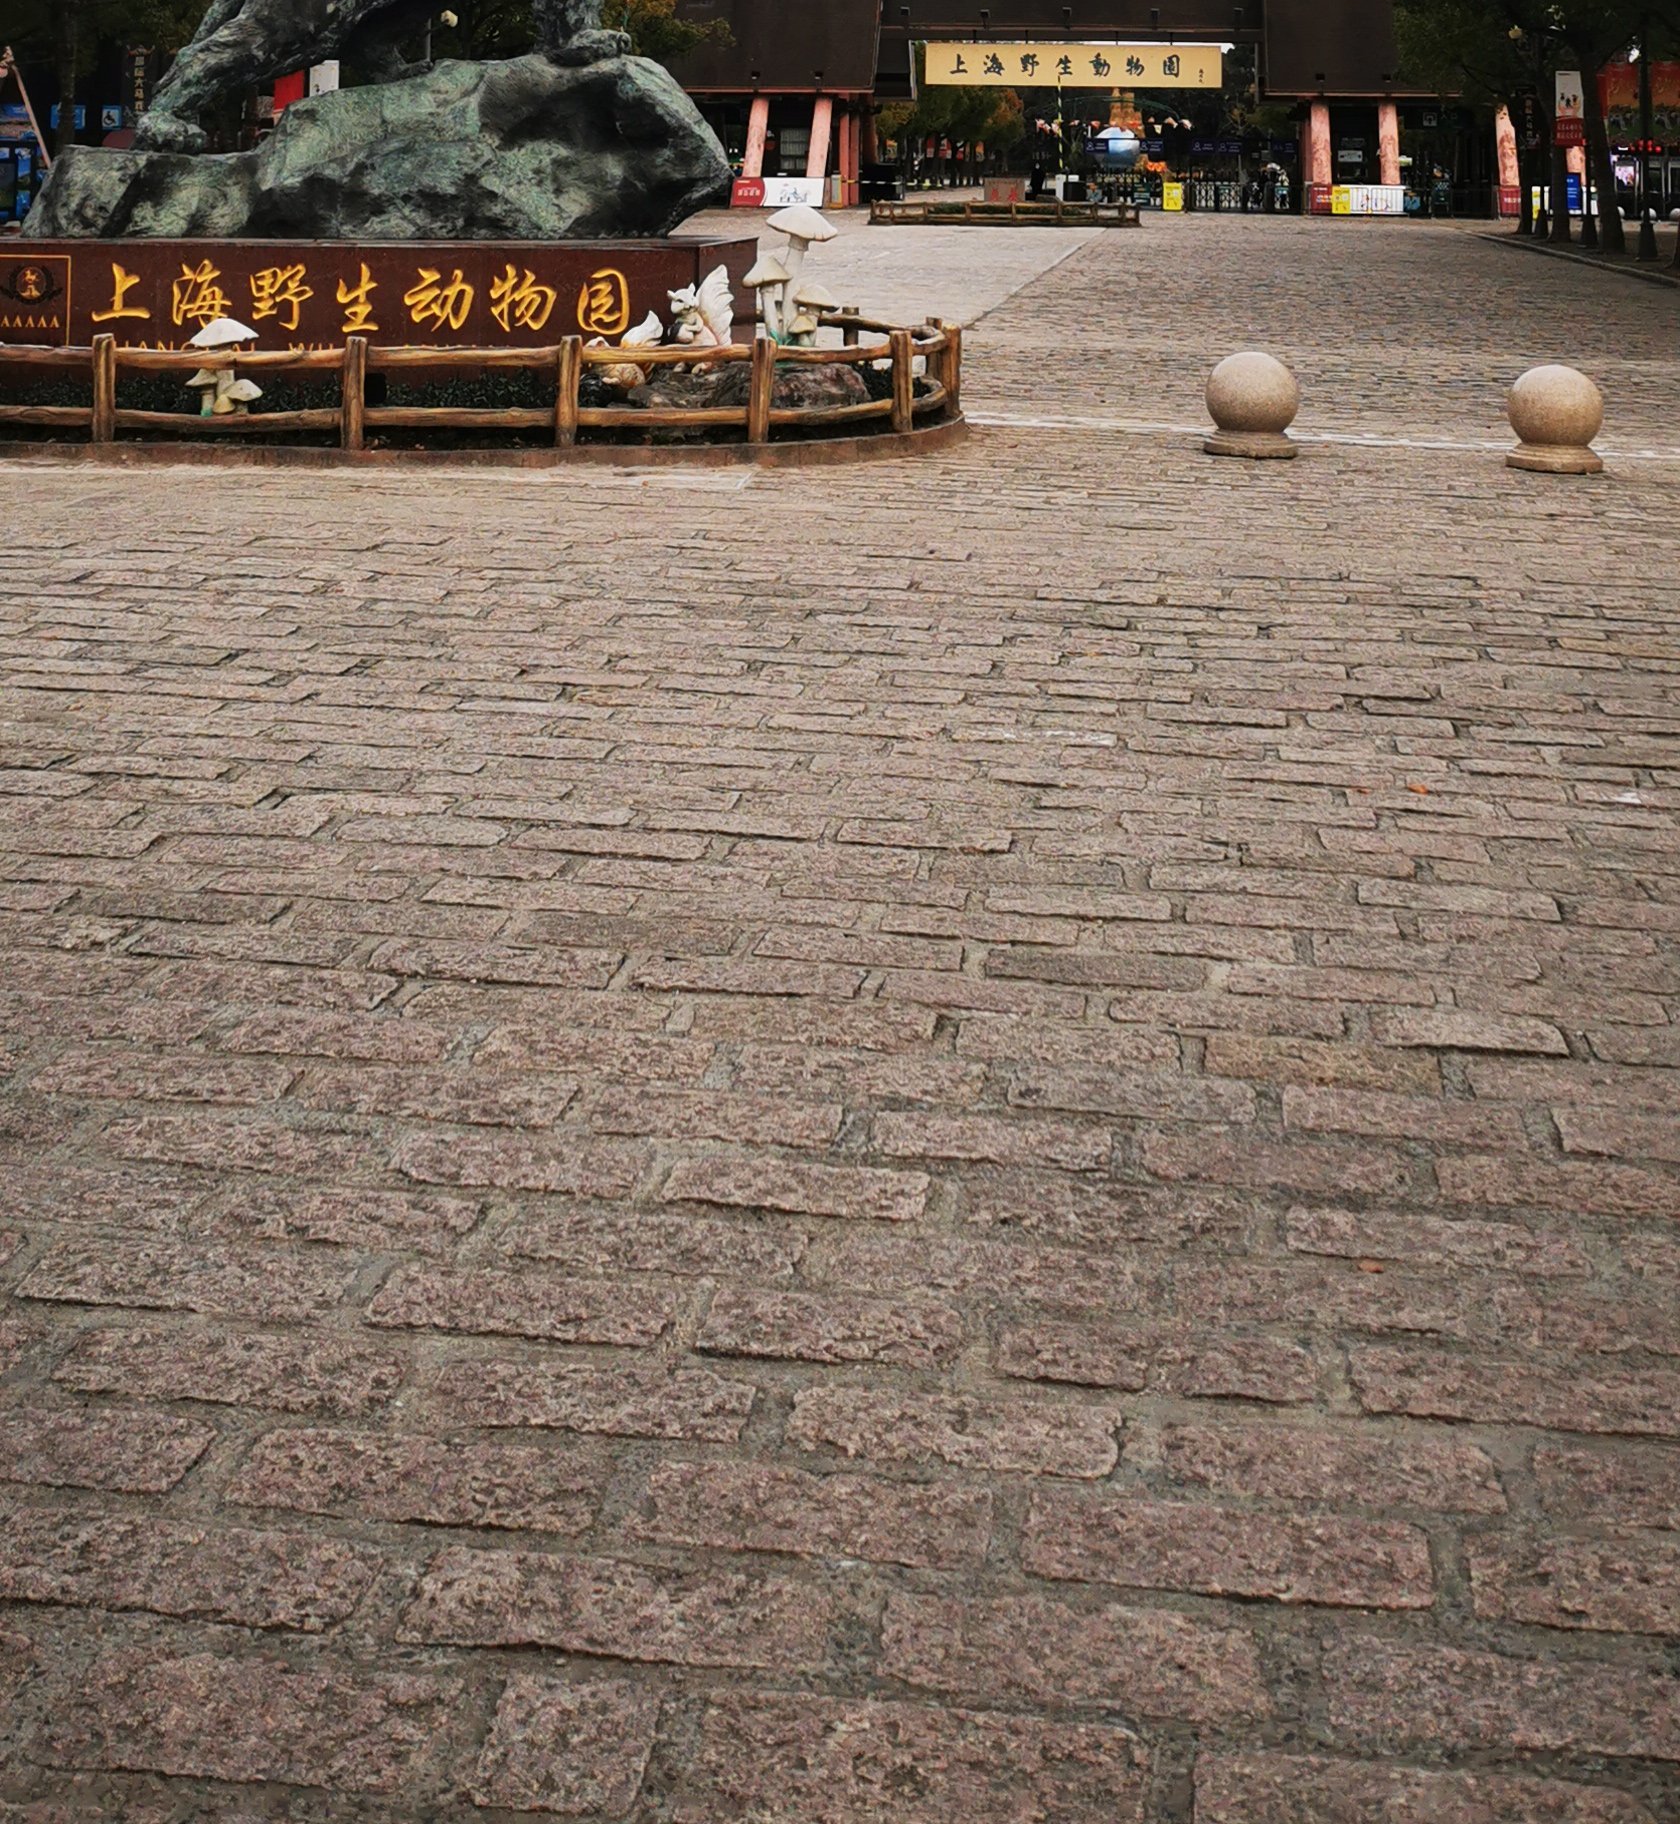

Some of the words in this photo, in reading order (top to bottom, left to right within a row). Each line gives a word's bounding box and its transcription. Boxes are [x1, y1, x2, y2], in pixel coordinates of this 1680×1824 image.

[949, 52, 1181, 77] 上海野生動物園
[91, 258, 631, 335] 上海野生动物园
